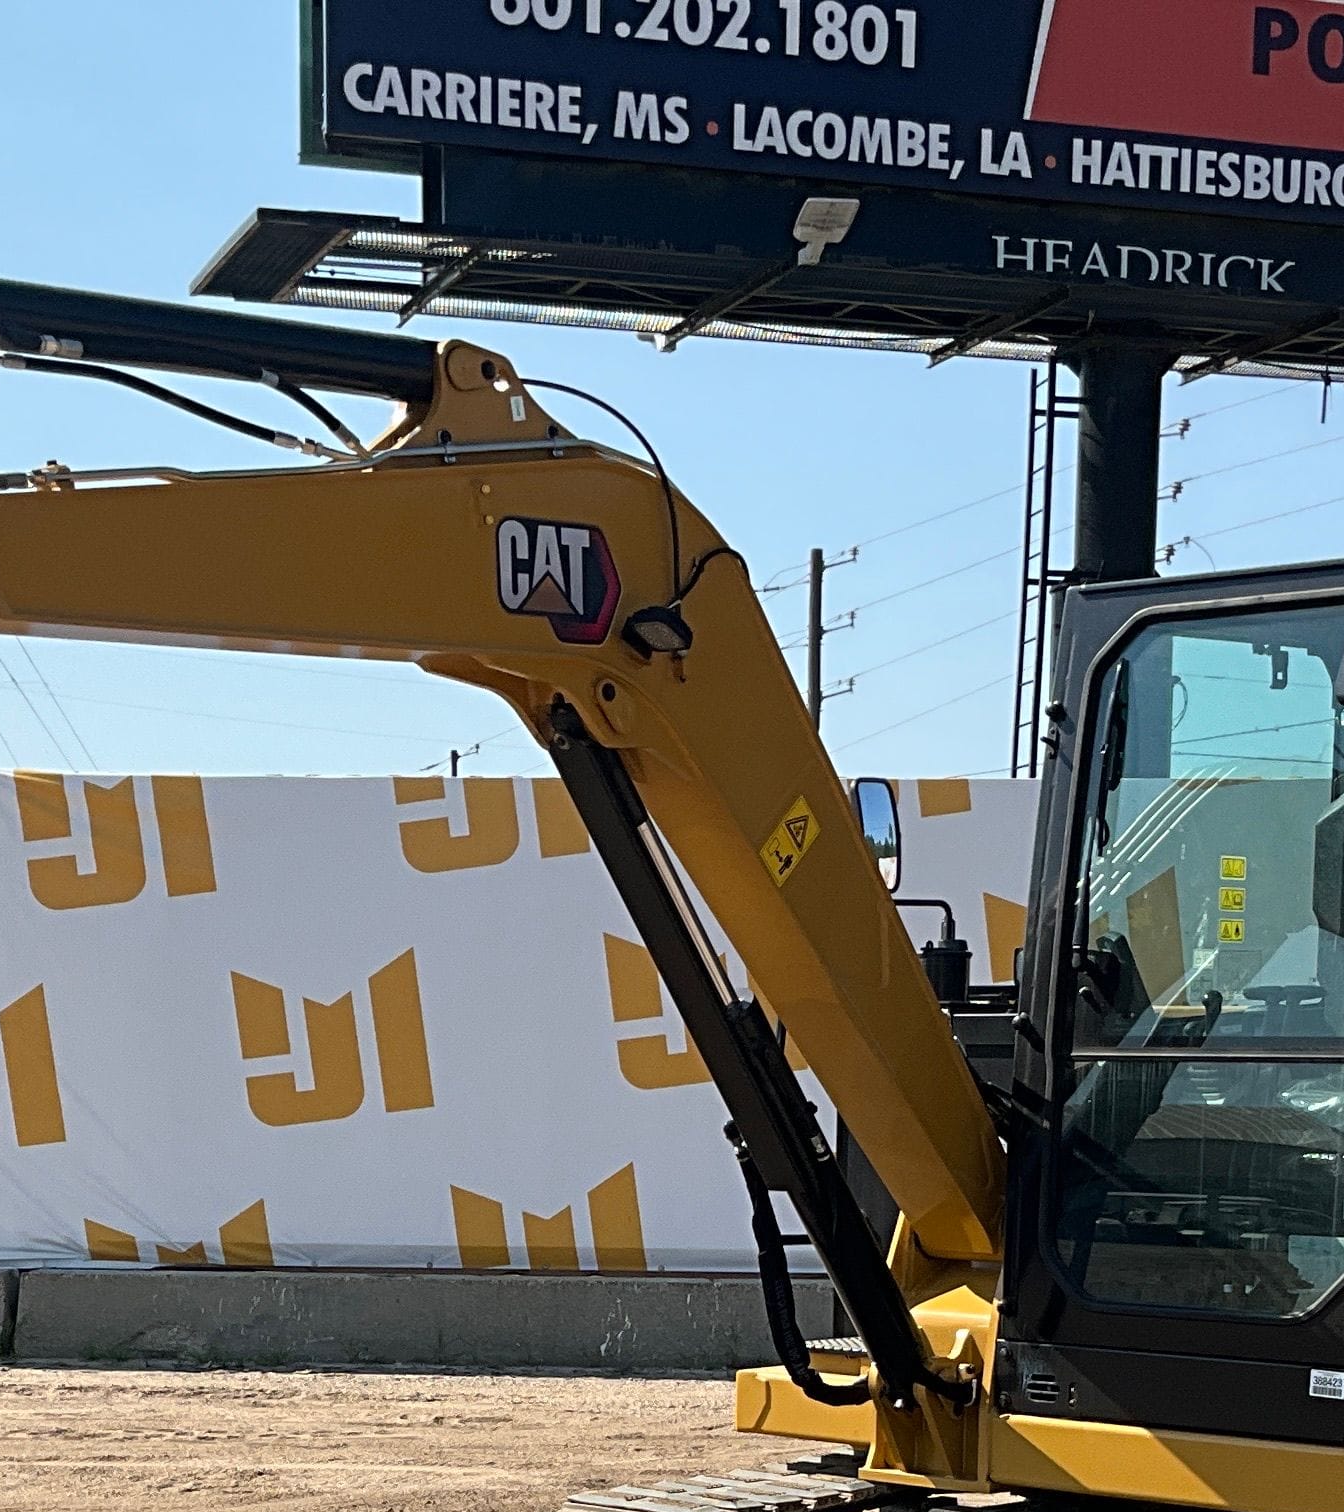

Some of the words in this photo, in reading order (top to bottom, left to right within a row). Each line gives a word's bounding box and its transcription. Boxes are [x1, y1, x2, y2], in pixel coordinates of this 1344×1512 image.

[343, 63, 598, 145] CARRIERE,
[613, 91, 690, 144] MS
[733, 103, 965, 180] LACOMBE,
[980, 128, 1033, 179] LA
[991, 235, 1296, 292] HEADRICK
[498, 519, 590, 615] CAT
